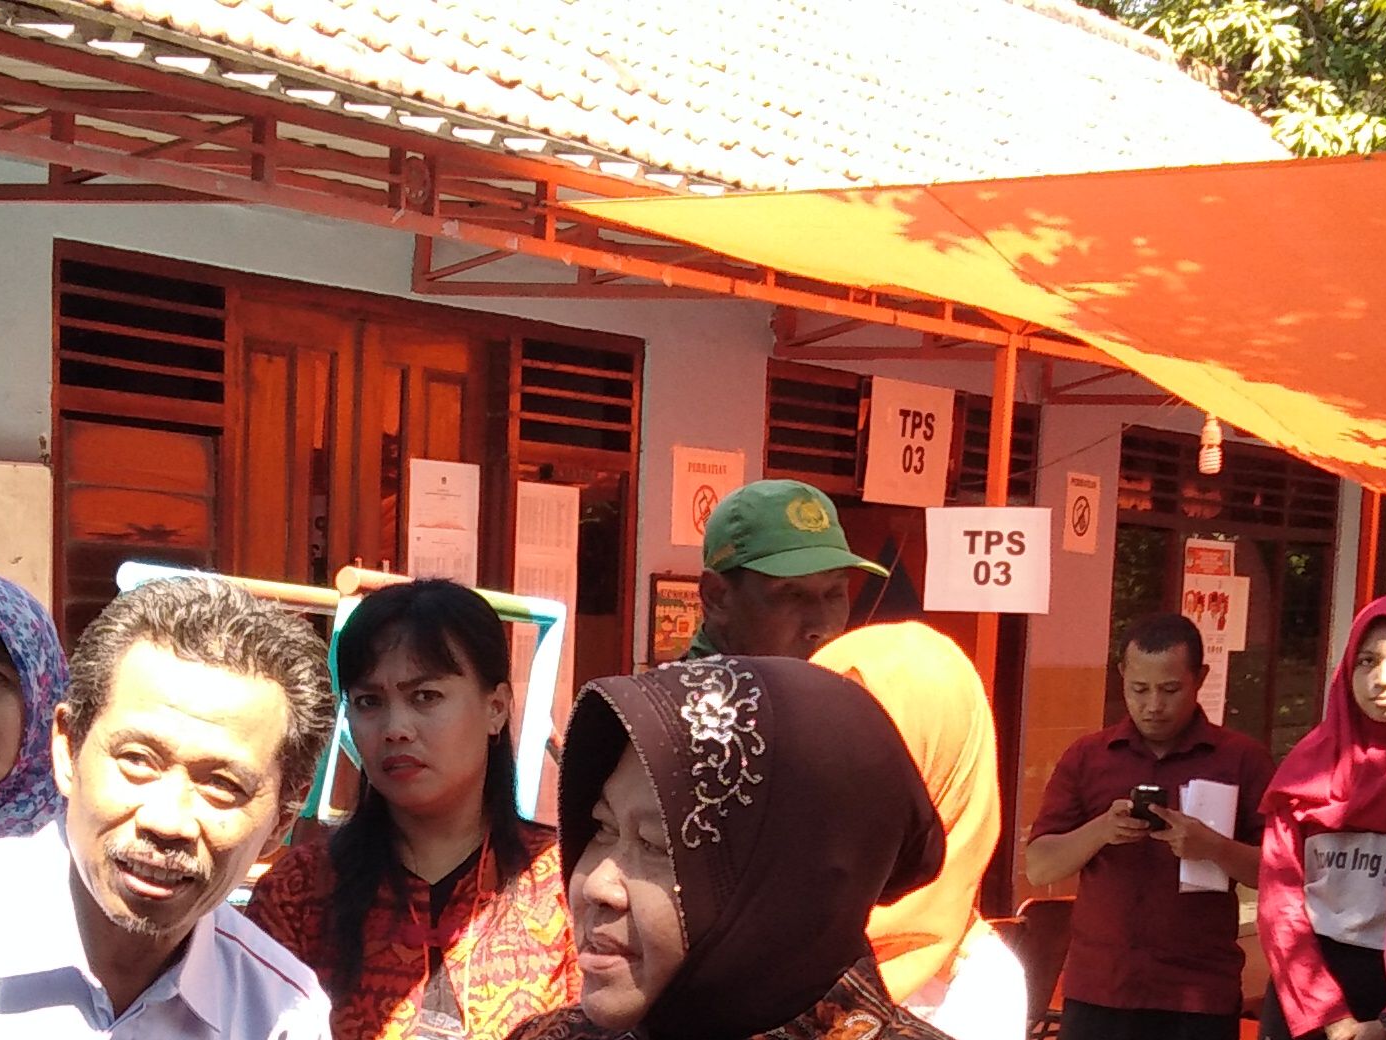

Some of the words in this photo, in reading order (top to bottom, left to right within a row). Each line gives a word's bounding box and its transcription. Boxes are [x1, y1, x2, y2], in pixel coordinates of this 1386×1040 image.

[898, 408, 936, 442] TPS
[901, 444, 926, 475] 03
[962, 530, 1027, 556] TPS
[973, 560, 1012, 587] 03
[1350, 847, 1383, 878] Ing
